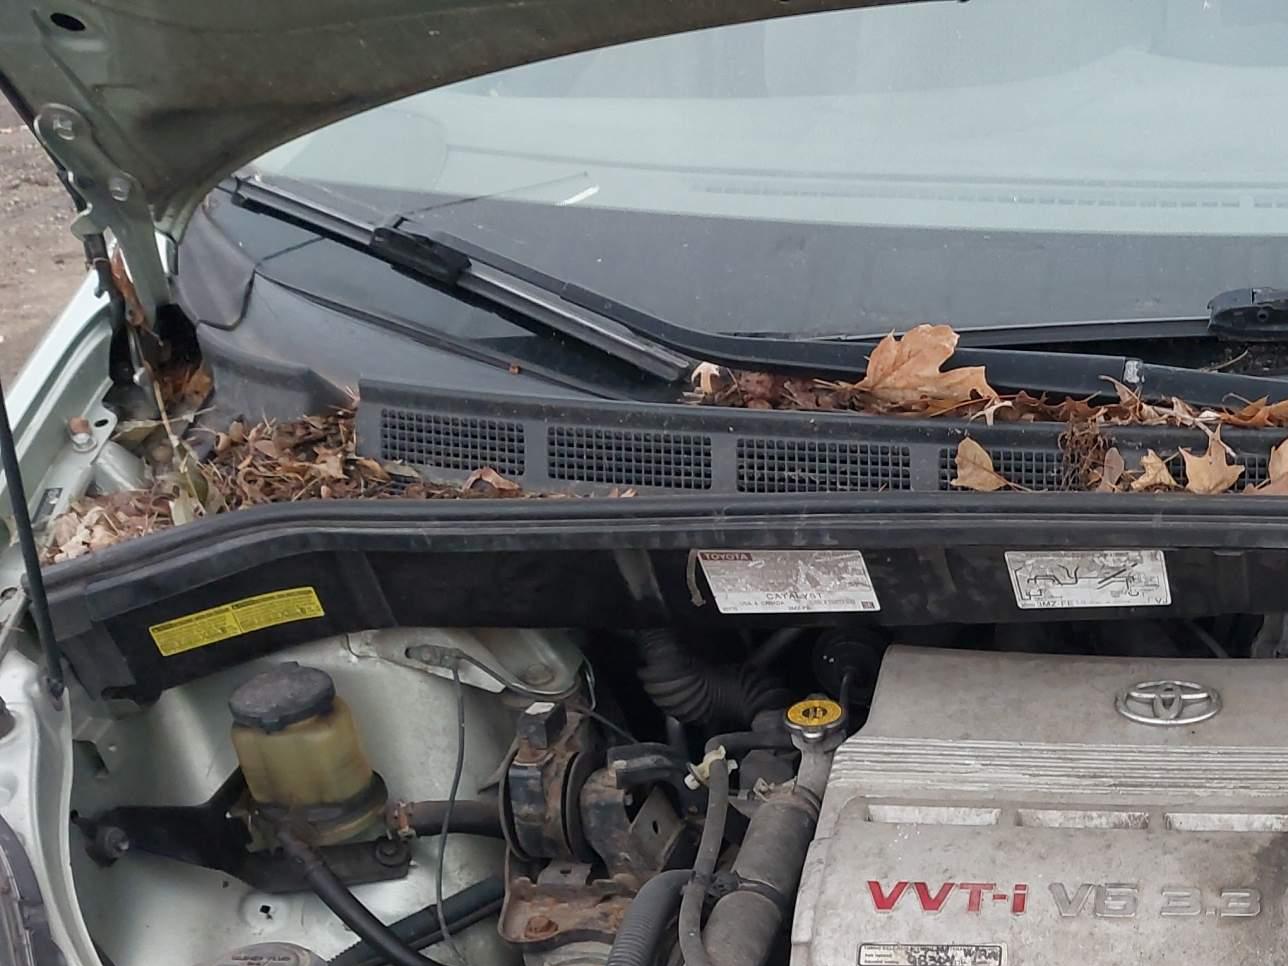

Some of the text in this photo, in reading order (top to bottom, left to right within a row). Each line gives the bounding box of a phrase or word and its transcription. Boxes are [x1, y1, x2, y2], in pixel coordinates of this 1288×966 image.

[766, 592, 823, 600] CATALYST
[867, 880, 1263, 917] VVT-i V6 3.3
